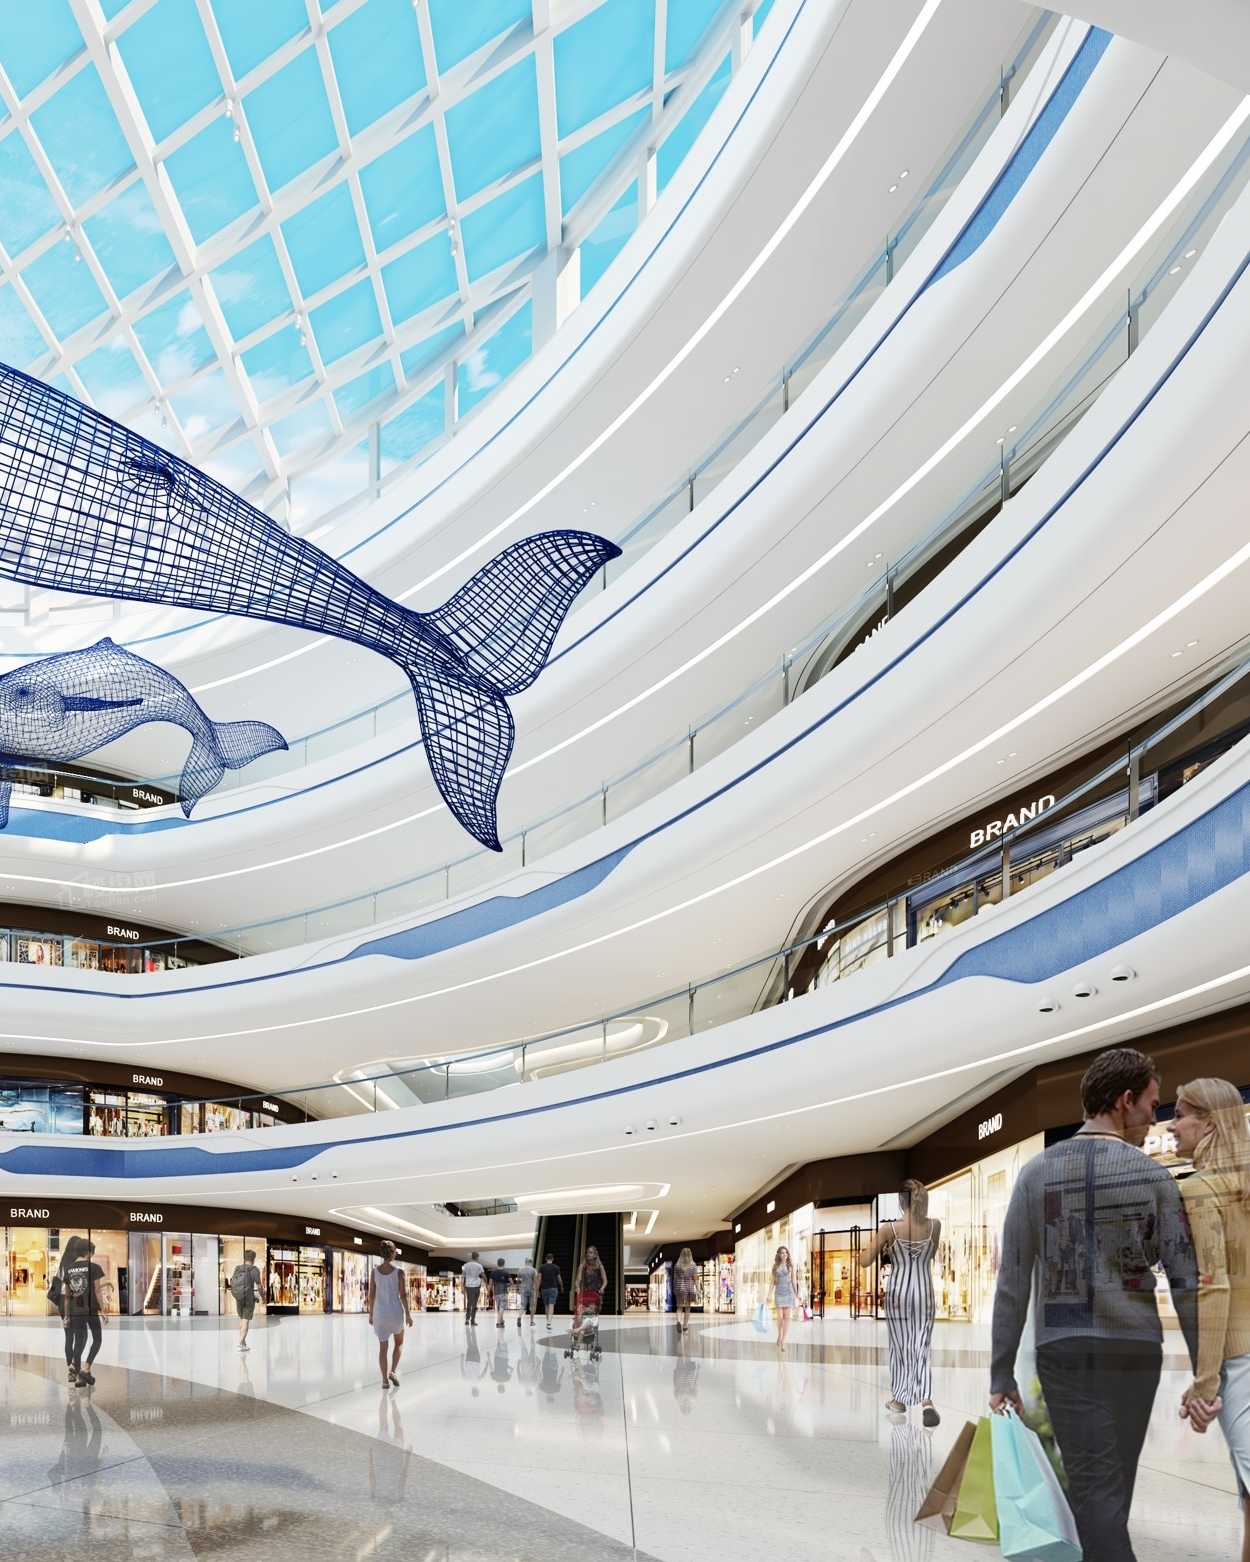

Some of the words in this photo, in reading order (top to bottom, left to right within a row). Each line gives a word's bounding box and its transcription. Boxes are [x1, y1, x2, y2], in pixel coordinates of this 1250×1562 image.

[132, 788, 164, 806] BRAND
[970, 795, 1055, 848] BRAND
[107, 925, 140, 940] BRAND
[132, 1074, 164, 1087] BRAND
[978, 1112, 1003, 1141] BRAND
[10, 1208, 50, 1219] BRAND
[130, 1212, 164, 1223] BRAND
